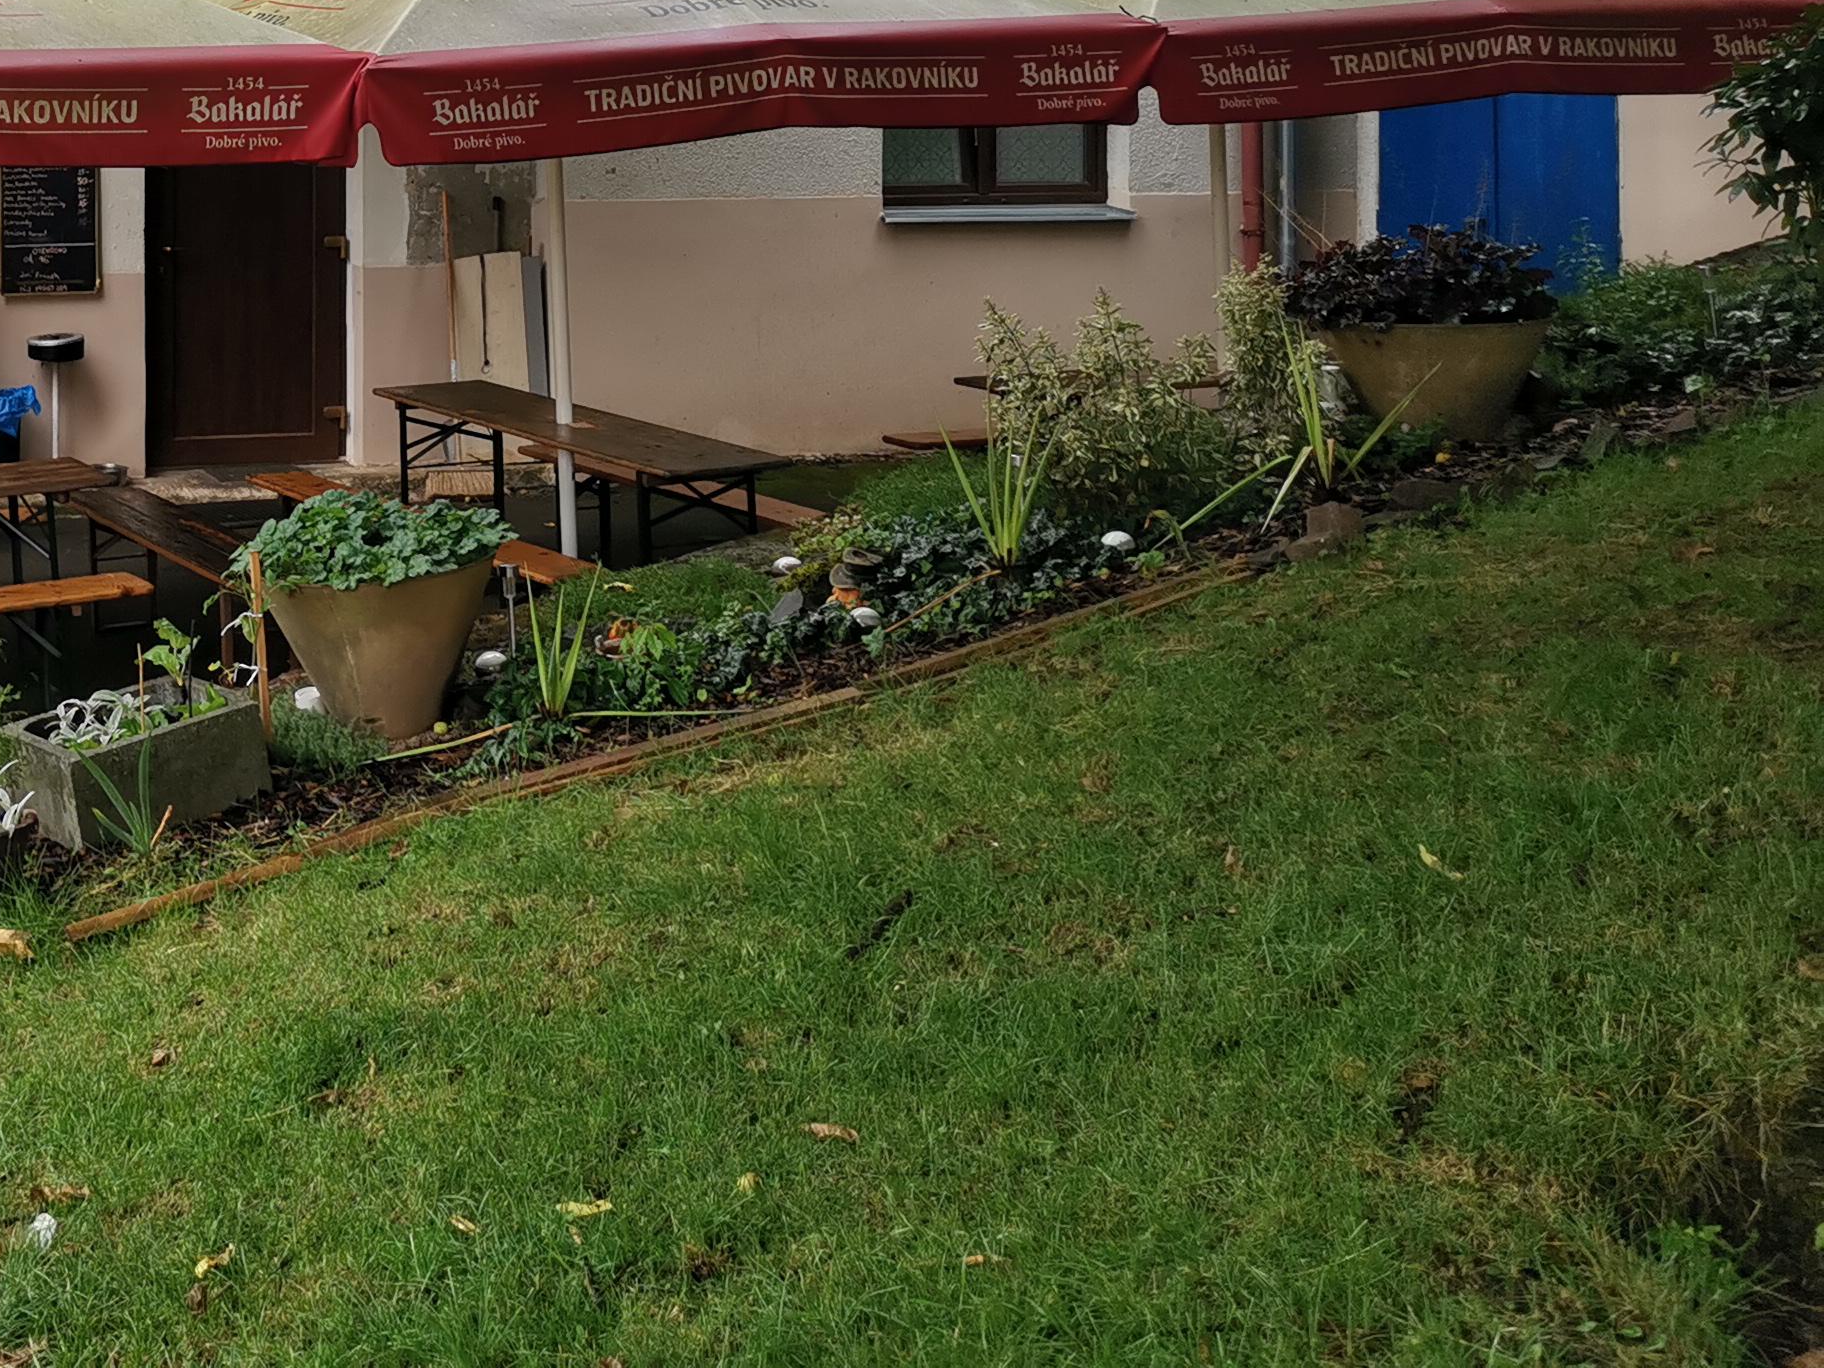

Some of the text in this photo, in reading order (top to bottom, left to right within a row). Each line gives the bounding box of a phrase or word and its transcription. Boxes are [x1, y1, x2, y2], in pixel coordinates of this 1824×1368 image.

[1049, 43, 1084, 58] 1454
[1224, 43, 1257, 58] 1454
[1329, 32, 1677, 77] TRADIČNÍ PIVOVAR V RAKOVNÍKU
[1018, 58, 1121, 87] Bakalář
[1198, 57, 1292, 87] Bakalář
[226, 76, 265, 91] 1454
[464, 77, 501, 93] 1454
[583, 61, 980, 113] TRADIČNÍ PIVOVAR V RAKOVNÍKU
[185, 93, 304, 124] Bakalář
[431, 92, 541, 126] Bakalář
[1037, 95, 1107, 112] Dobré pivo.
[205, 133, 284, 151] Dobré pivo.
[453, 132, 527, 151] Dobré pivo.
